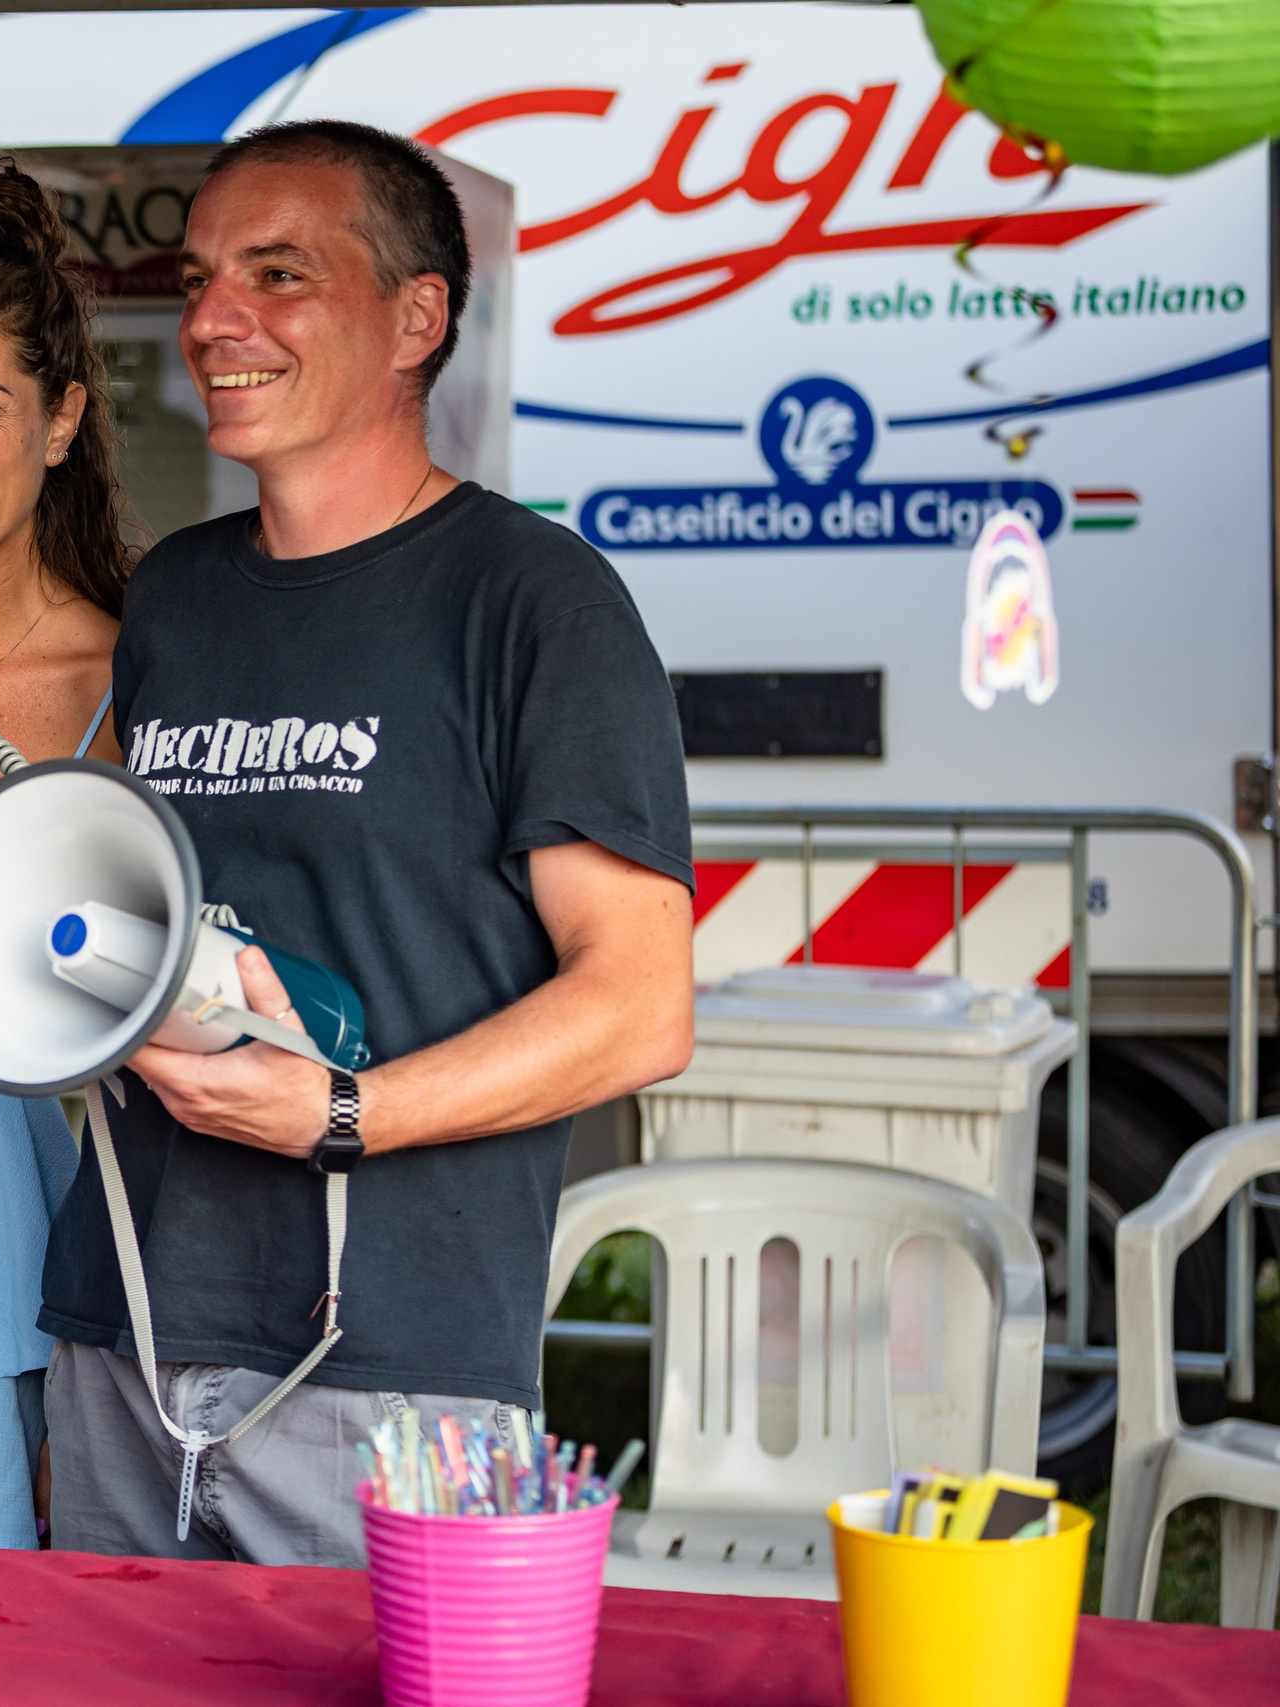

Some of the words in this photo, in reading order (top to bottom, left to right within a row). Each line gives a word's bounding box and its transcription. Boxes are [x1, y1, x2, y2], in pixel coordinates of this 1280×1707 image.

[792, 282, 832, 324] di
[846, 278, 933, 322] solo
[1072, 274, 1247, 318] italiano
[594, 490, 814, 544] Caseificio
[820, 488, 896, 540] del
[184, 777, 203, 794] LA
[206, 777, 246, 796] SELLA
[248, 776, 266, 793] DI
[268, 775, 287, 792] UN
[288, 774, 363, 794] COSACCO
